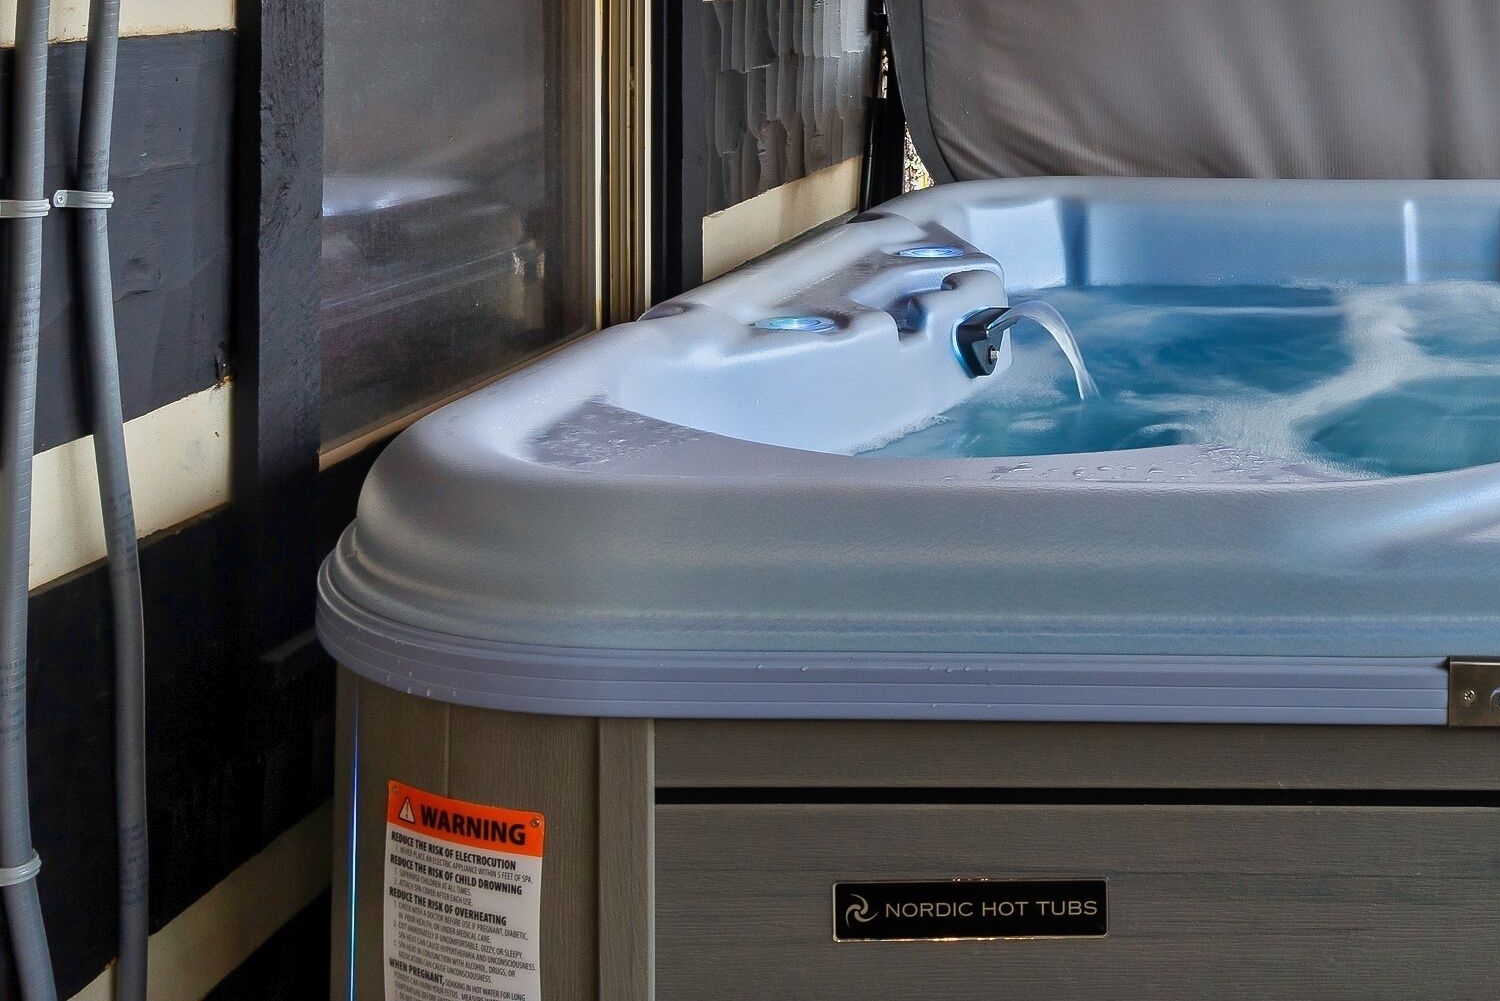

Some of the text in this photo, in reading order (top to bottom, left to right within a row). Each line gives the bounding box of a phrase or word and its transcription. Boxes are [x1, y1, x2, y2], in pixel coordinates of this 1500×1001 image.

[420, 804, 526, 846] WARNING
[391, 831, 516, 871] REDUCE THE RISK OF ELECTROCUTION
[390, 854, 522, 896] REDUCE THE RISK OF CHILD DROWNING
[389, 886, 507, 926] REDUCE THE RISK OF OVERHEATING
[885, 900, 1098, 918] NORDIC HOT TUBS
[389, 957, 408, 972] WHEN
[408, 964, 445, 985] PREGNANT,
